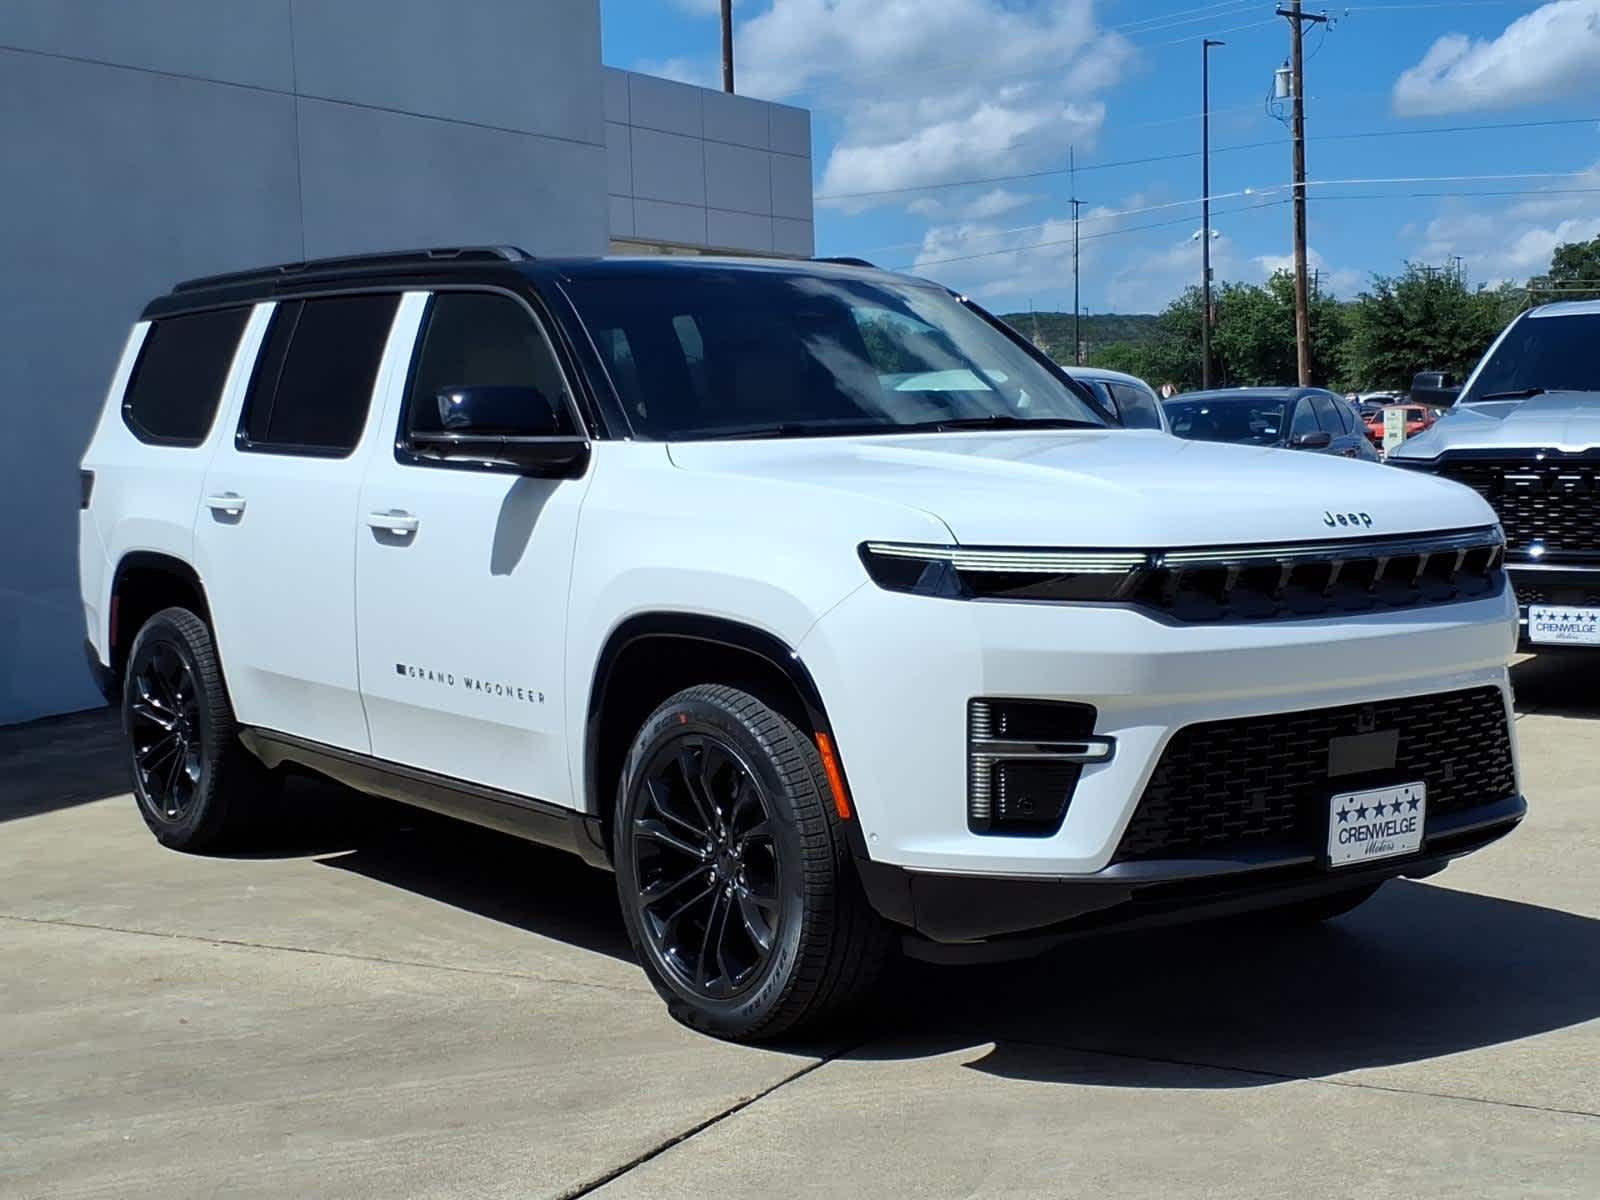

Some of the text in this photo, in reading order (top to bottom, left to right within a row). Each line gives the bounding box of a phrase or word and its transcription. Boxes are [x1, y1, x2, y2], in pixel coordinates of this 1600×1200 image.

[1323, 511, 1373, 528] Jeep
[1535, 623, 1597, 633] CRENWELGE
[409, 666, 545, 705] GRAND WAGONEER
[1338, 816, 1417, 845] CRENWELGE
